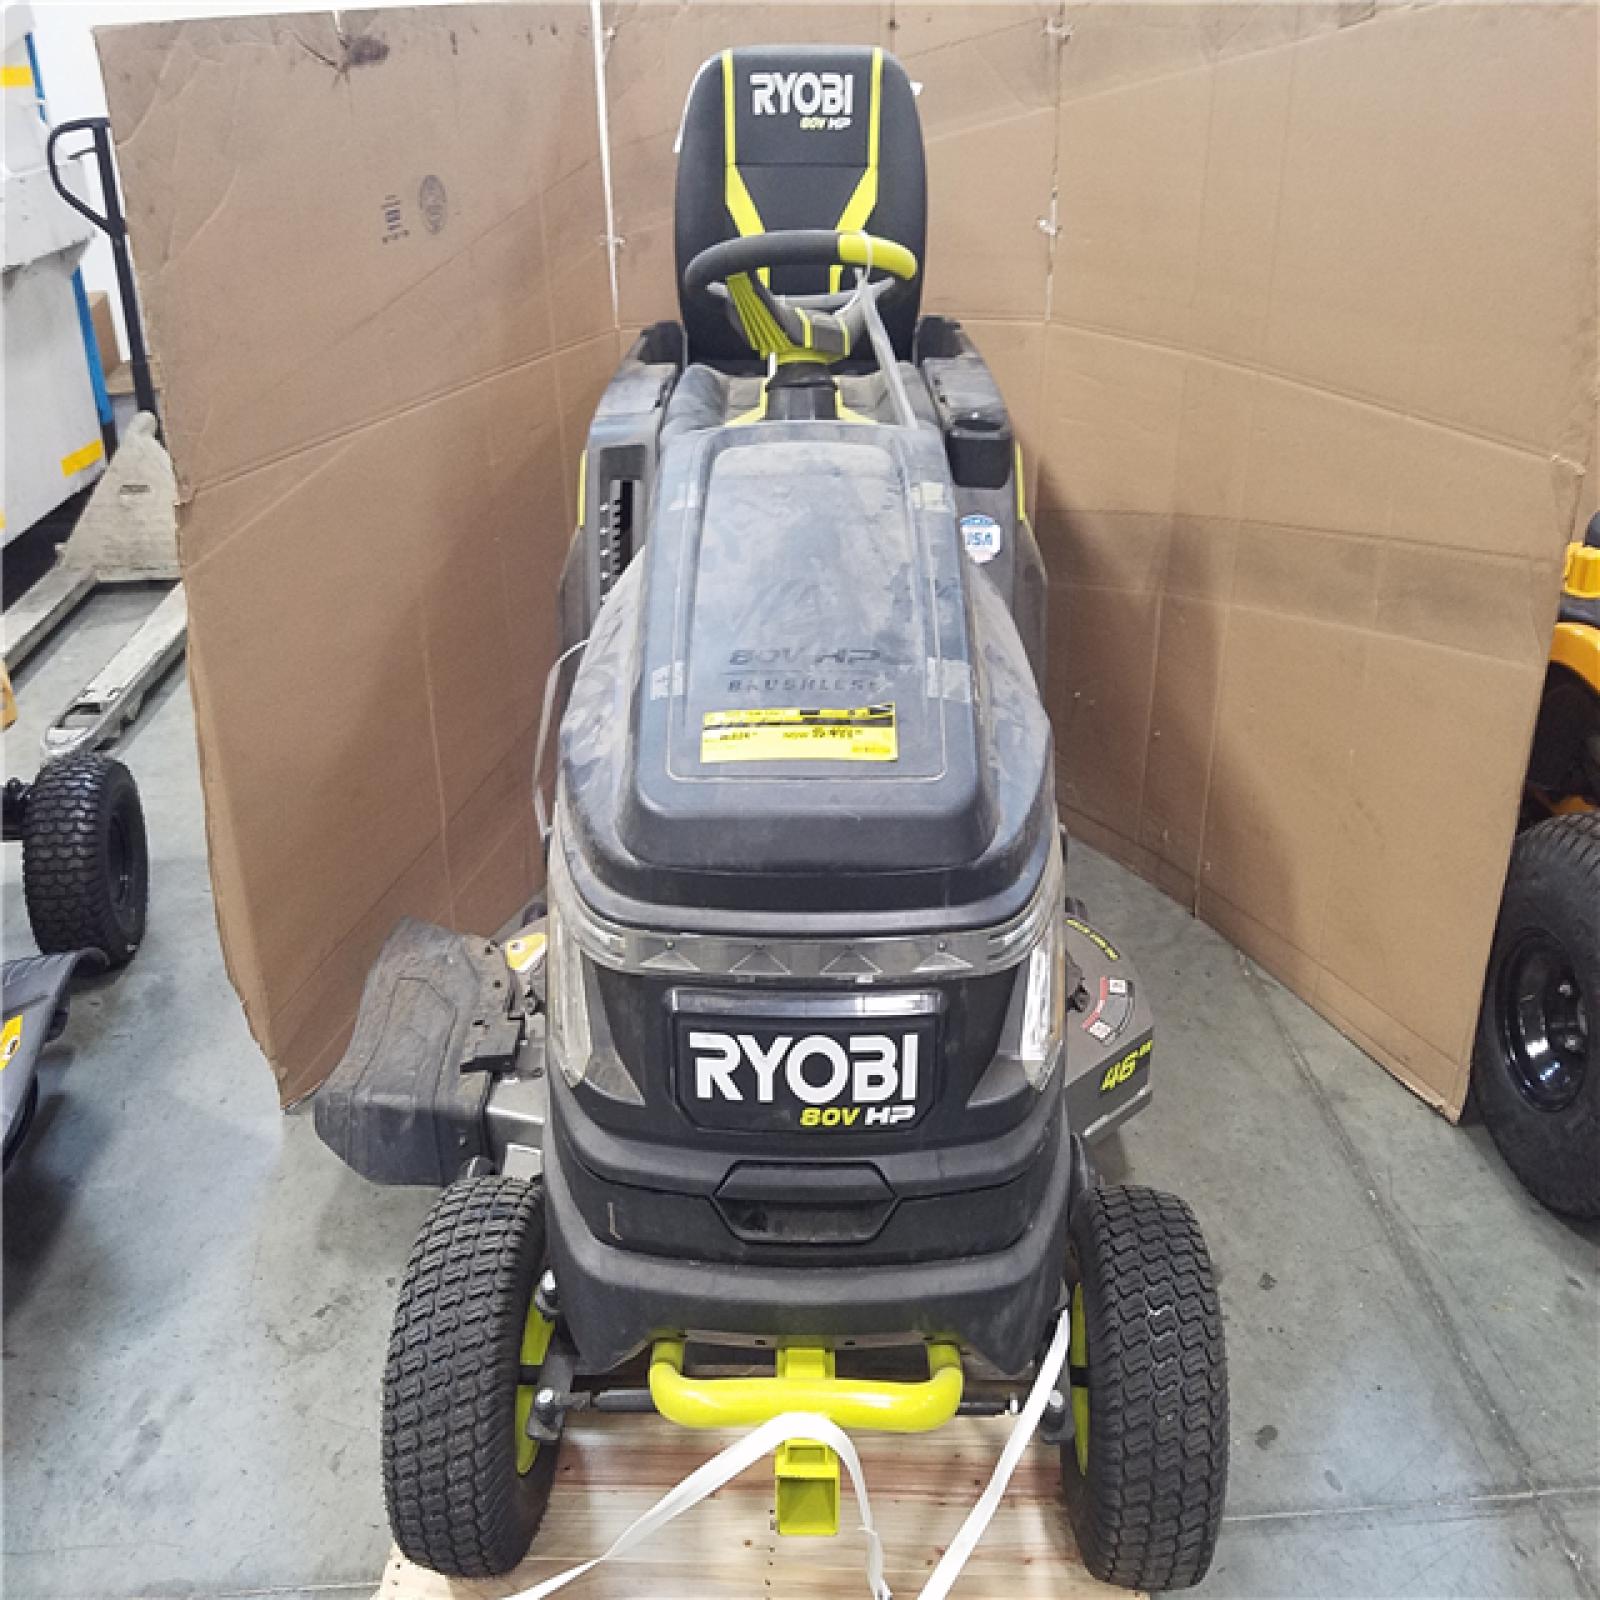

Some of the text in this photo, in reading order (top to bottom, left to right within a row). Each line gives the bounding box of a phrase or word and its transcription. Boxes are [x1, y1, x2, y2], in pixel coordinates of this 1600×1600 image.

[750, 72, 853, 116] RYOBI
[689, 1031, 919, 1104] RYOBI
[1100, 1050, 1139, 1091] 46
[800, 1104, 916, 1127] 80V HP
